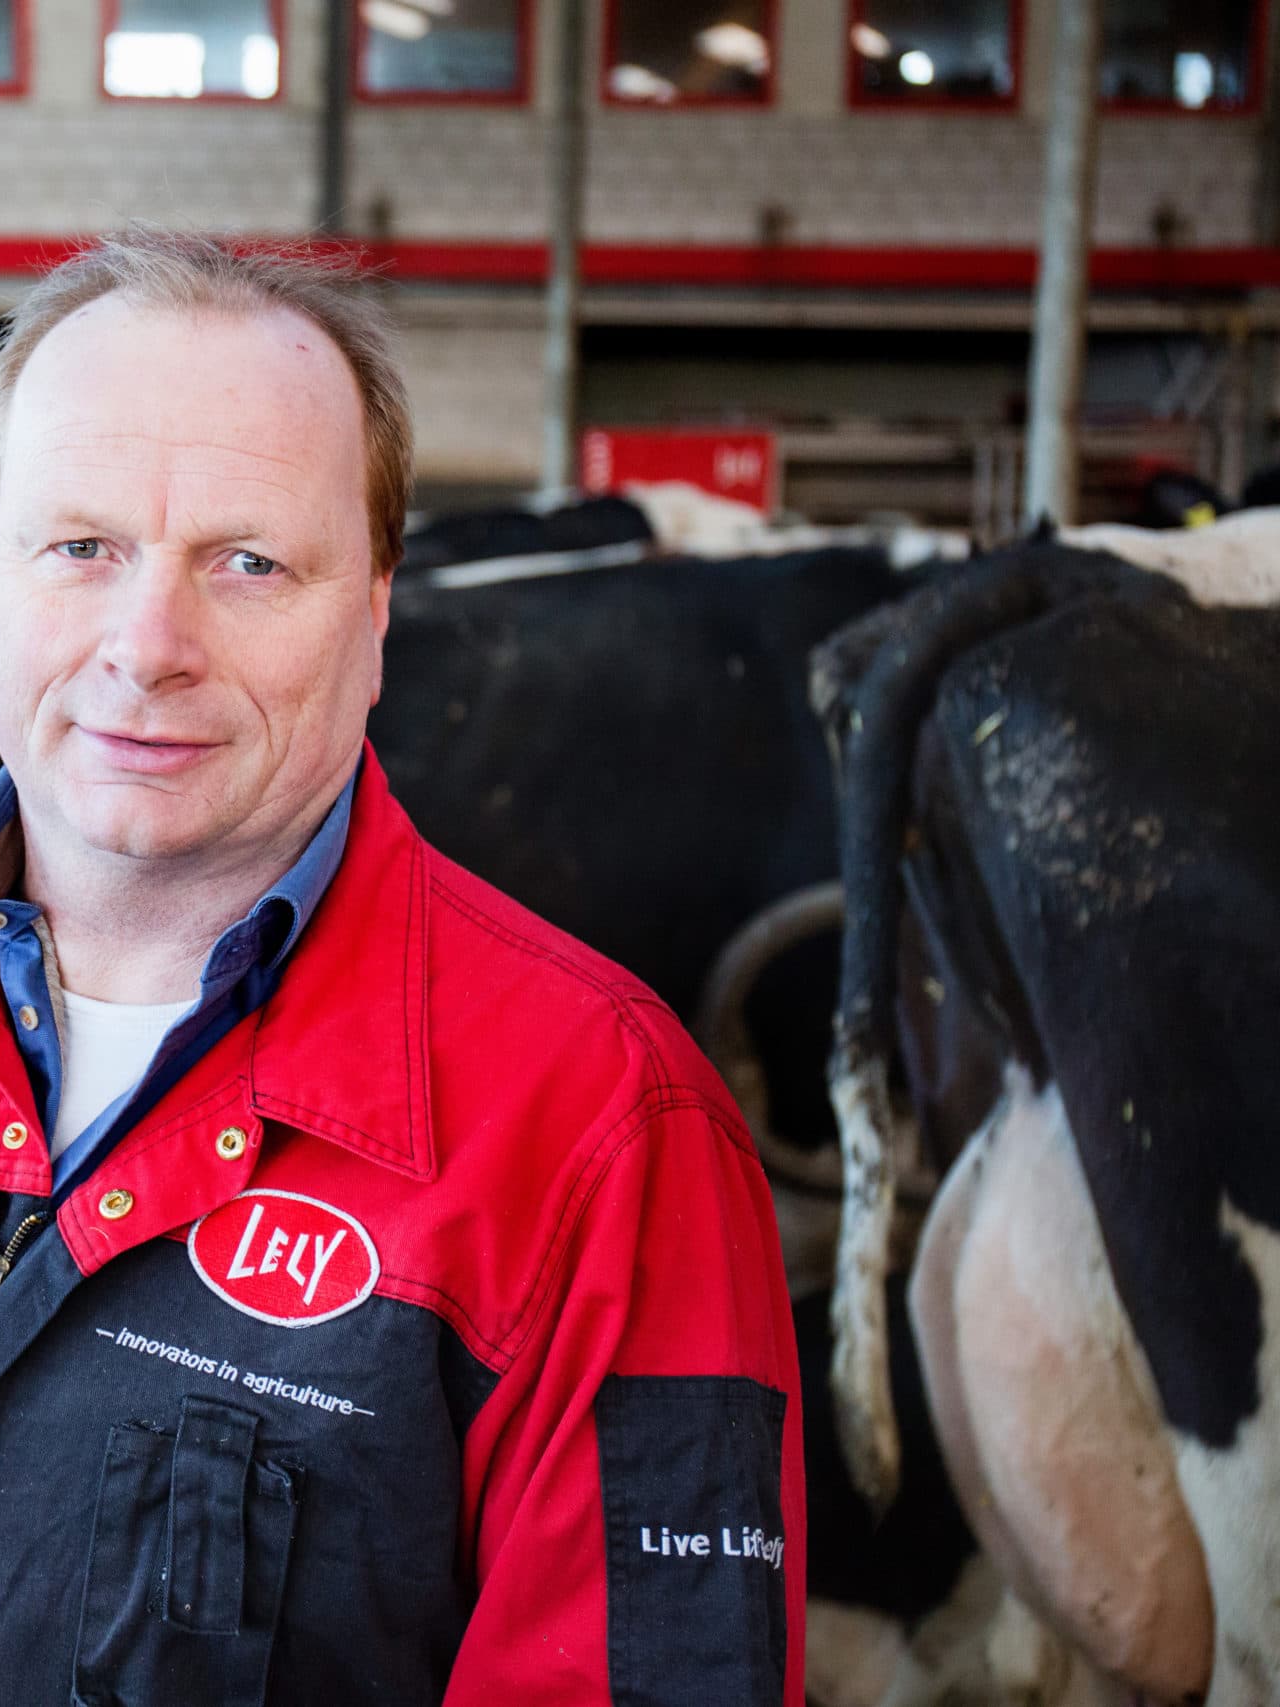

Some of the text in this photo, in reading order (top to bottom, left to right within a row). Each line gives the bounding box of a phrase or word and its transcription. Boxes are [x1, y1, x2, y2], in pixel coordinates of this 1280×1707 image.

[226, 1203, 347, 1306] LELY
[115, 1326, 354, 1416] innovators in agriculture
[640, 1526, 711, 1556] Live
